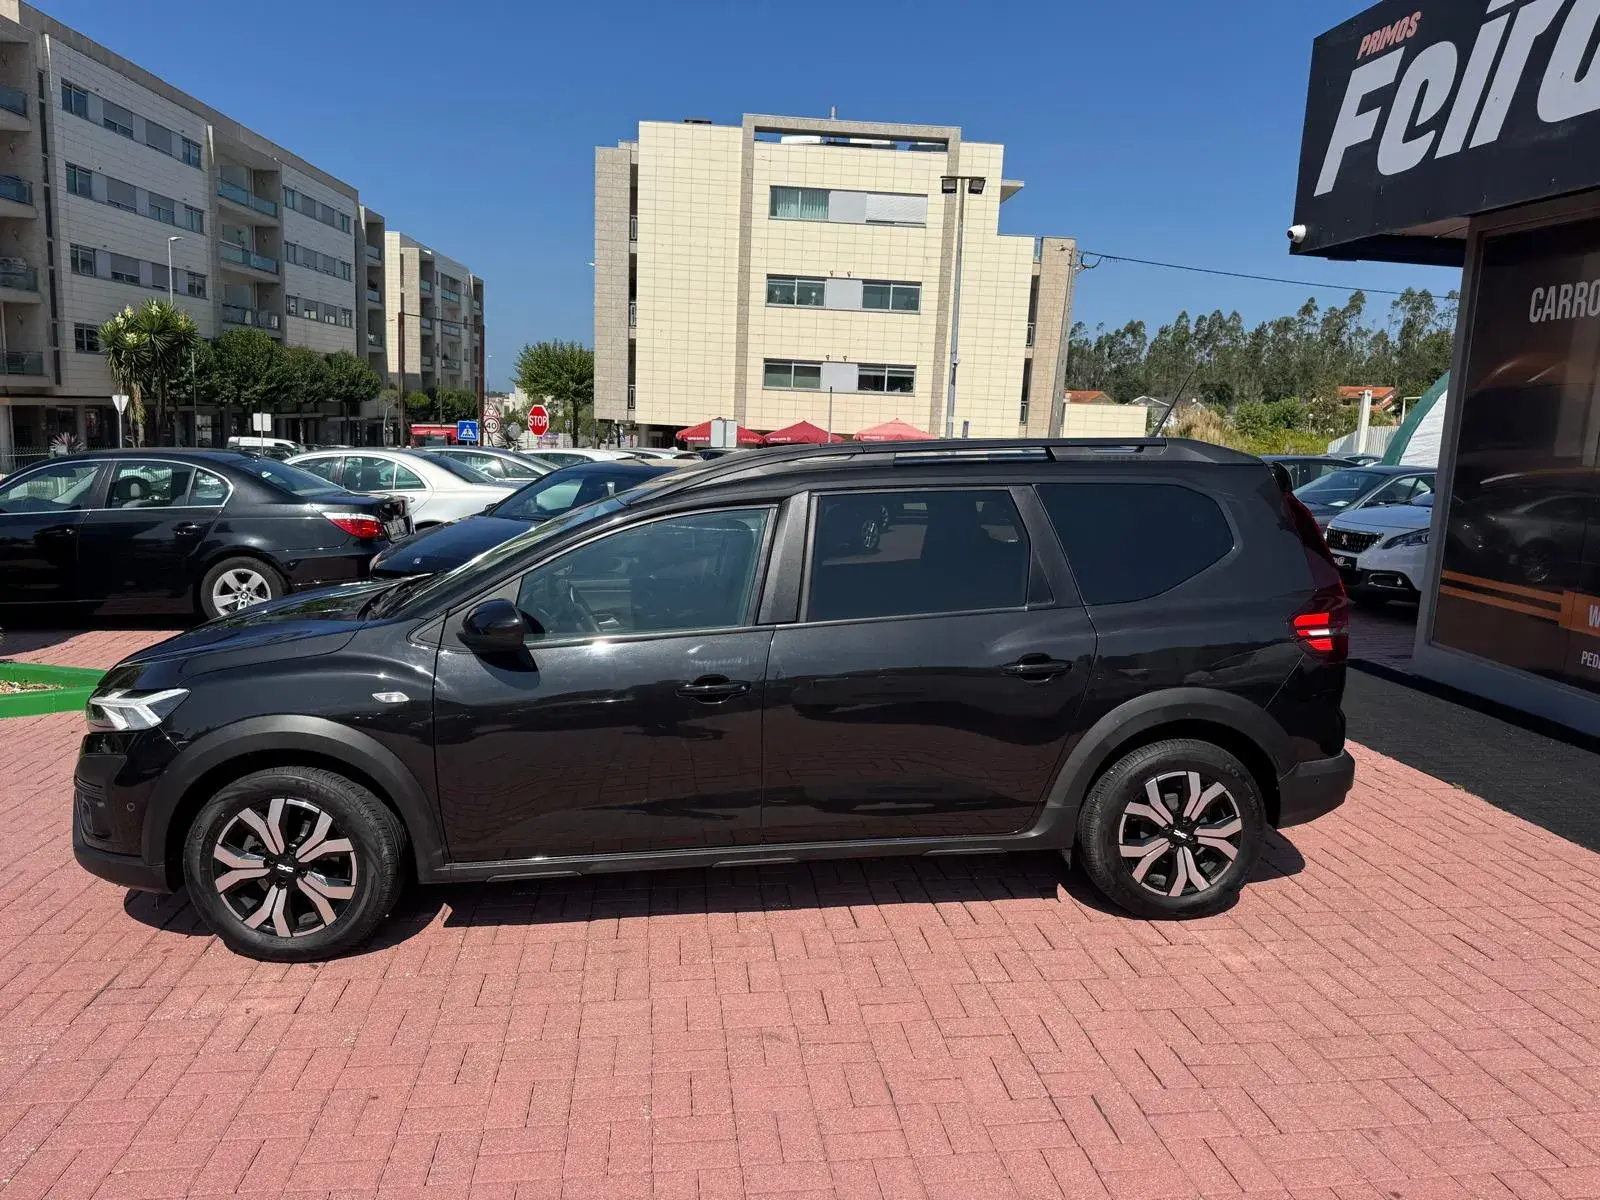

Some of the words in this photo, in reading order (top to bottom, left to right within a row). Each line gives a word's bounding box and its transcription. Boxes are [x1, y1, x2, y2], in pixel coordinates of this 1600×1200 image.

[1356, 11, 1421, 60] PRIMOS
[529, 415, 547, 426] STOP
[1581, 650, 1600, 669] PED
